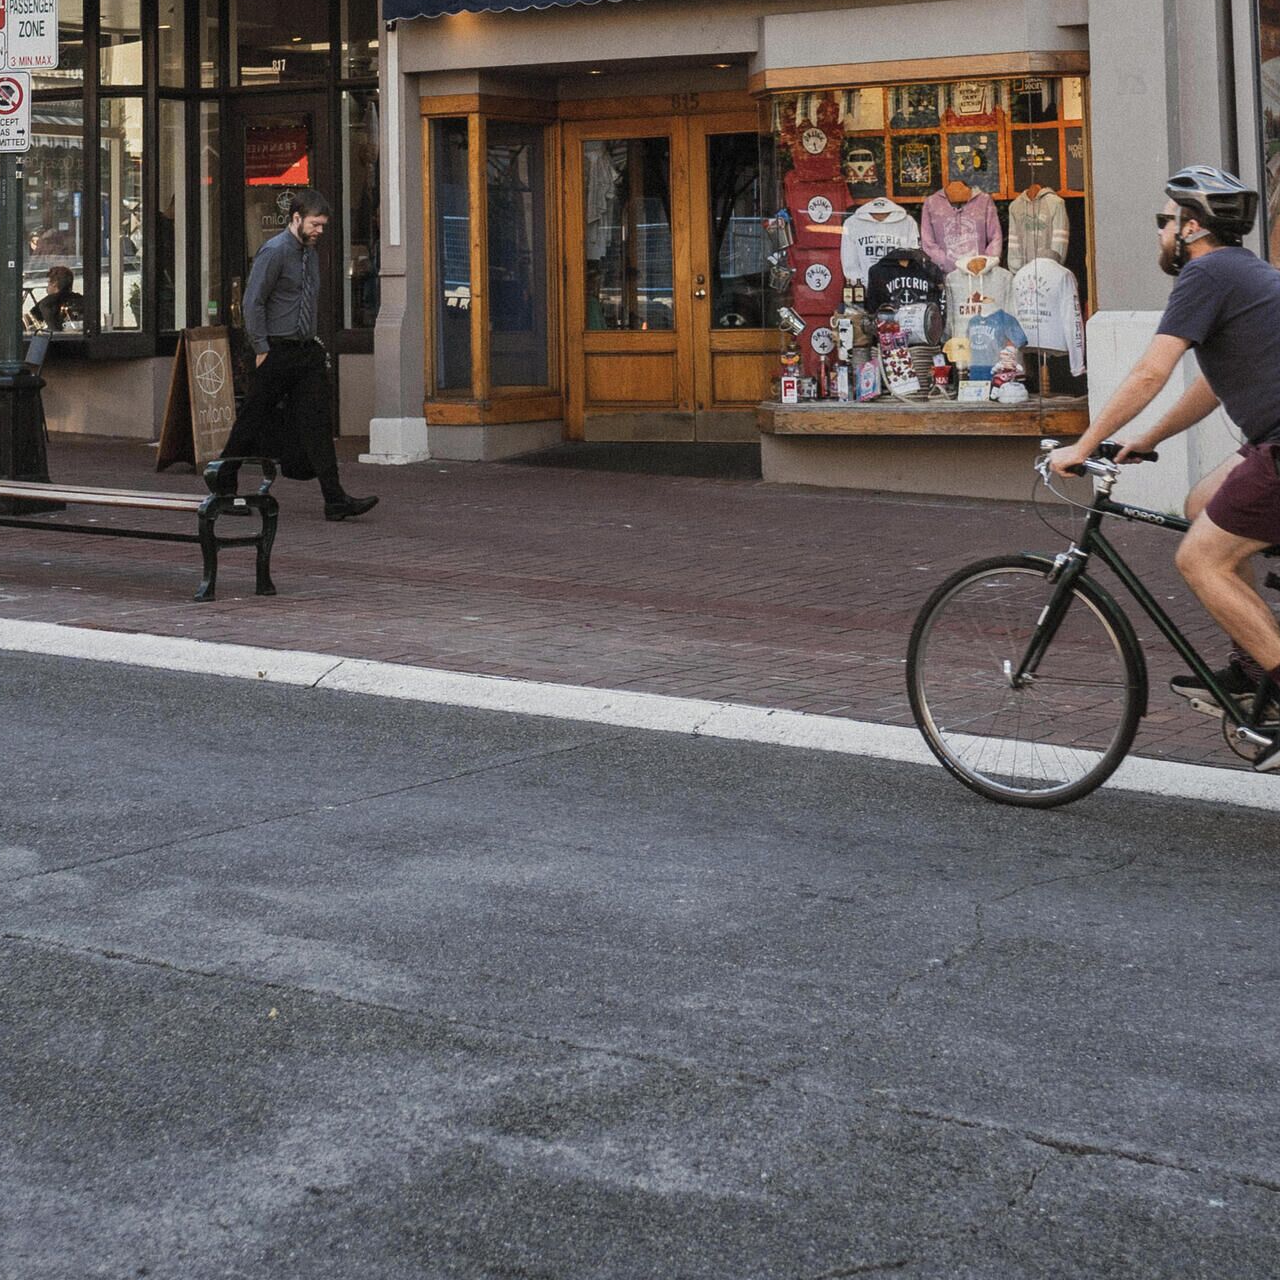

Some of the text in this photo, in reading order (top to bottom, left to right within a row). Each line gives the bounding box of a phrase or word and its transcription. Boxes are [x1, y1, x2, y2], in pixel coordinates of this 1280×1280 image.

[19, 20, 45, 37] ZONE
[10, 57, 16, 66] 3
[272, 59, 286, 71] 817
[0, 128, 10, 137] AS
[809, 199, 831, 211] DRUNK
[858, 234, 902, 246] VICTORIA
[806, 267, 829, 279] DRUNK
[815, 278, 821, 288] 3
[886, 276, 929, 293] VICTORIA
[819, 342, 827, 351] 4
[198, 405, 232, 424] milano
[1123, 507, 1166, 524] NORCO
